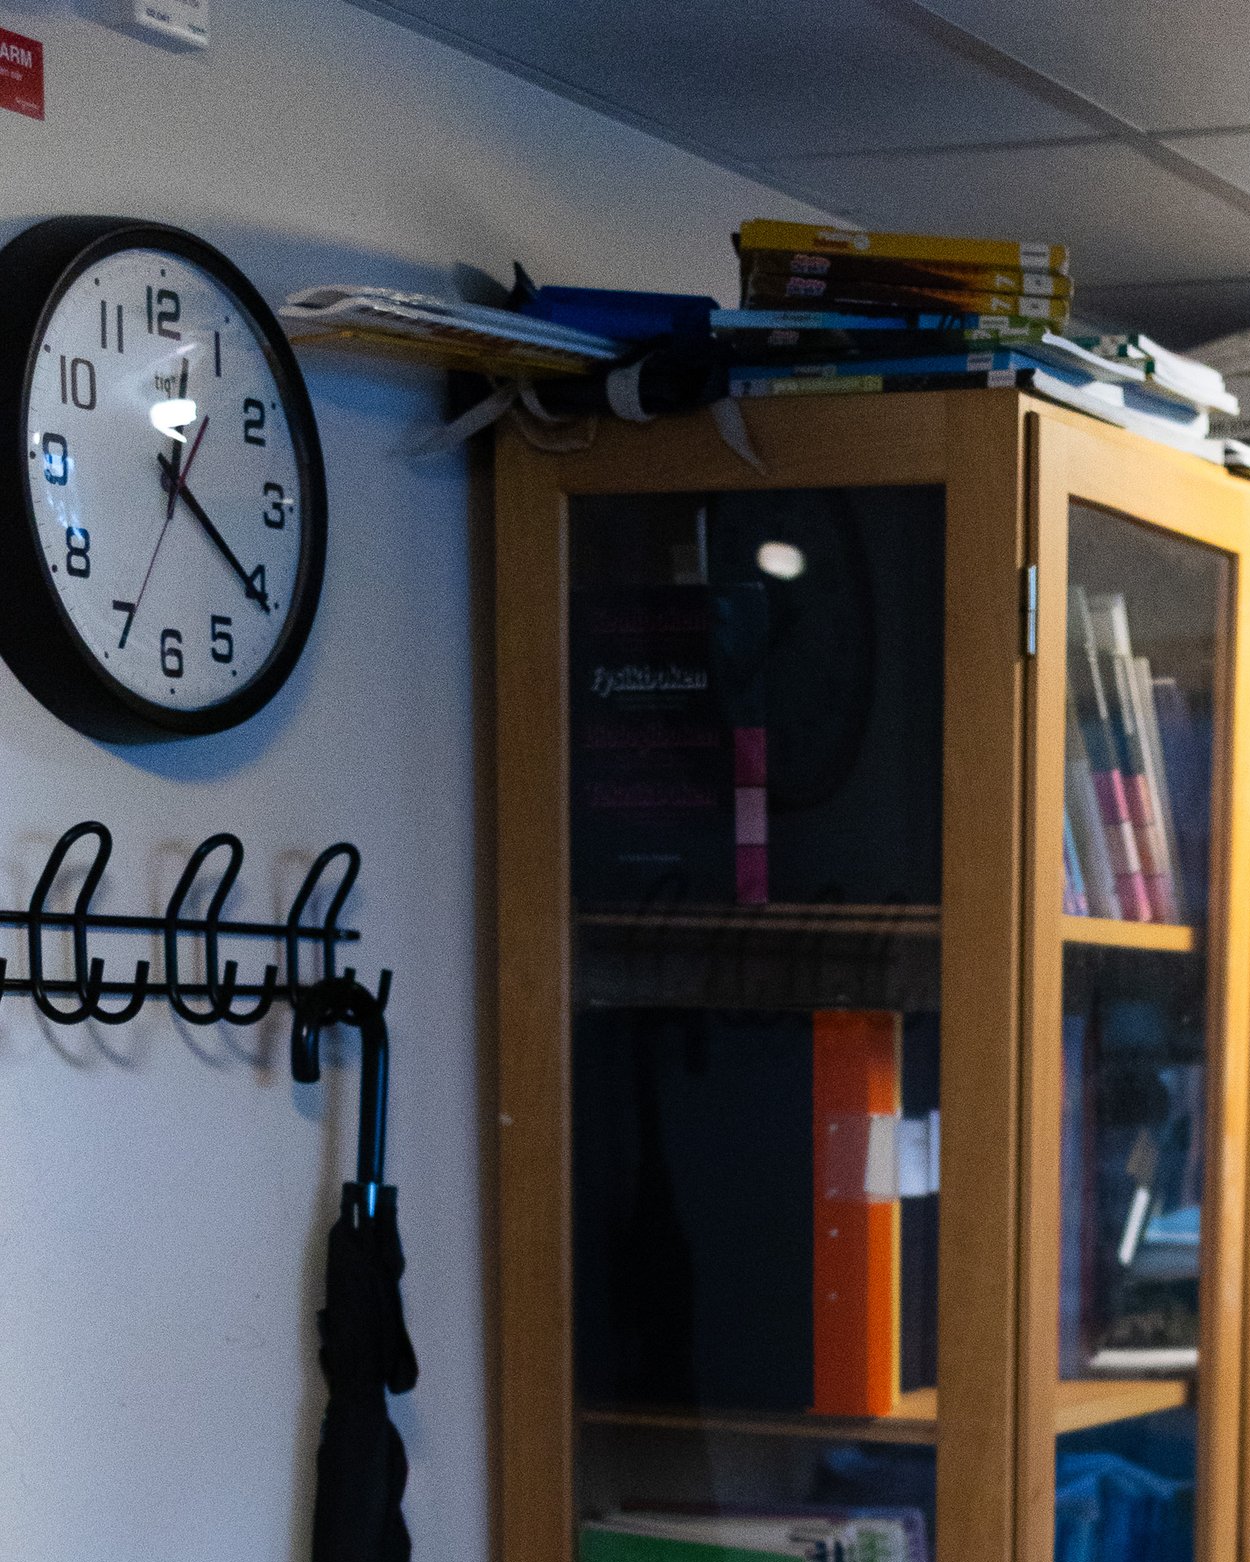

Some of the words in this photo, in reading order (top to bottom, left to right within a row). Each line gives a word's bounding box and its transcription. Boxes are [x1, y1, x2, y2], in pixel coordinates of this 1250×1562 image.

[101, 300, 124, 353] 11
[147, 285, 181, 341] 12
[215, 331, 222, 377] 1
[60, 355, 96, 411] 10
[243, 398, 266, 447] 2
[42, 432, 68, 486] 9
[263, 482, 286, 529] 3
[66, 526, 91, 578] 8
[246, 564, 269, 601] 4
[112, 600, 136, 649] 7
[210, 615, 234, 664] 5
[160, 629, 184, 678] 6
